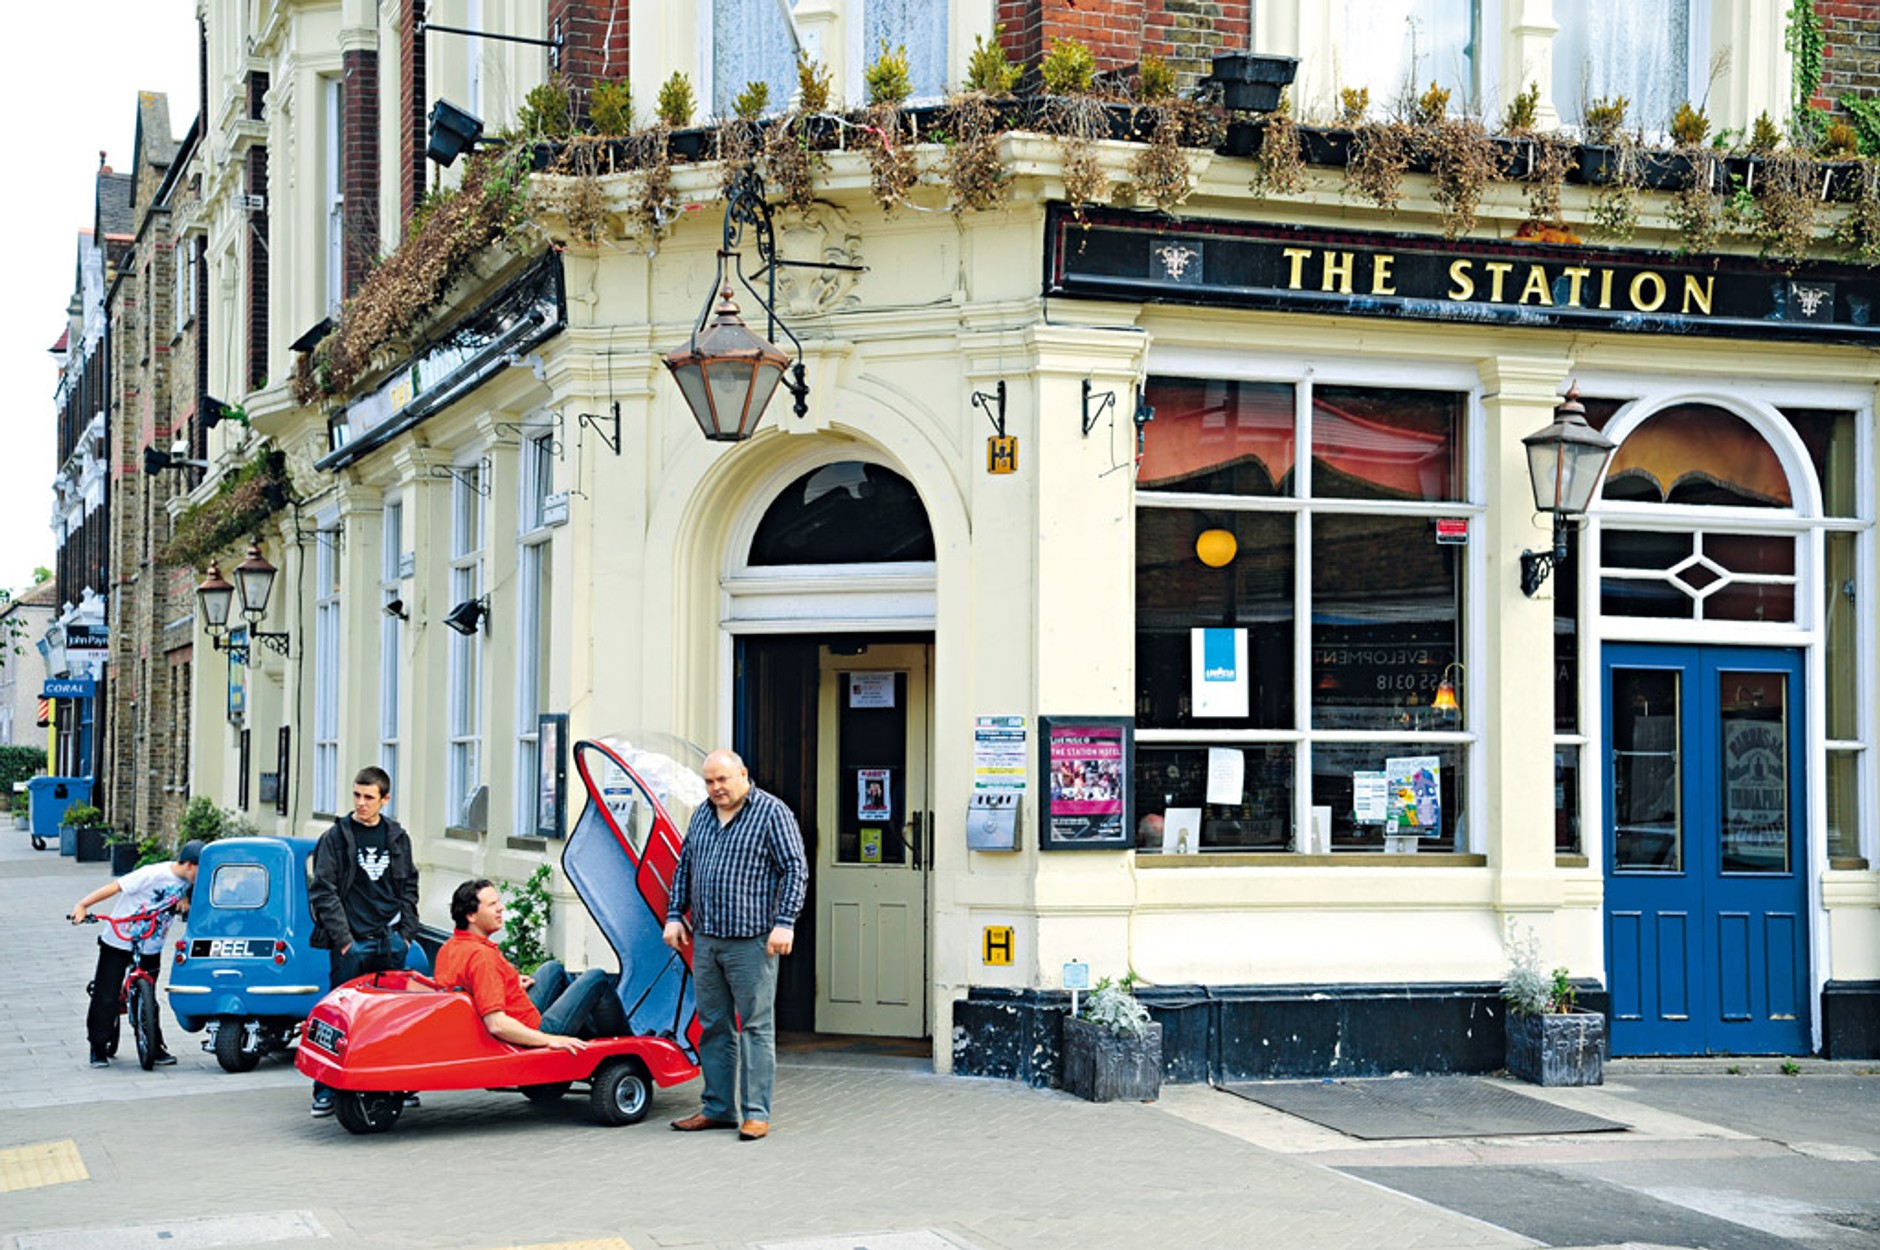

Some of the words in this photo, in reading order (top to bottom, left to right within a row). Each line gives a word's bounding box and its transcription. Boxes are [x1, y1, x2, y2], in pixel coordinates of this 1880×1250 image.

[1283, 248, 1396, 295] THE
[1448, 259, 1715, 315] STATION
[68, 635, 87, 647] John
[45, 683, 84, 693] CORAL
[1051, 748, 1065, 756] THE
[1067, 748, 1097, 756] STATION
[1099, 748, 1120, 756] HOTEL
[209, 940, 254, 957] PEEL
[986, 929, 1010, 962] H
